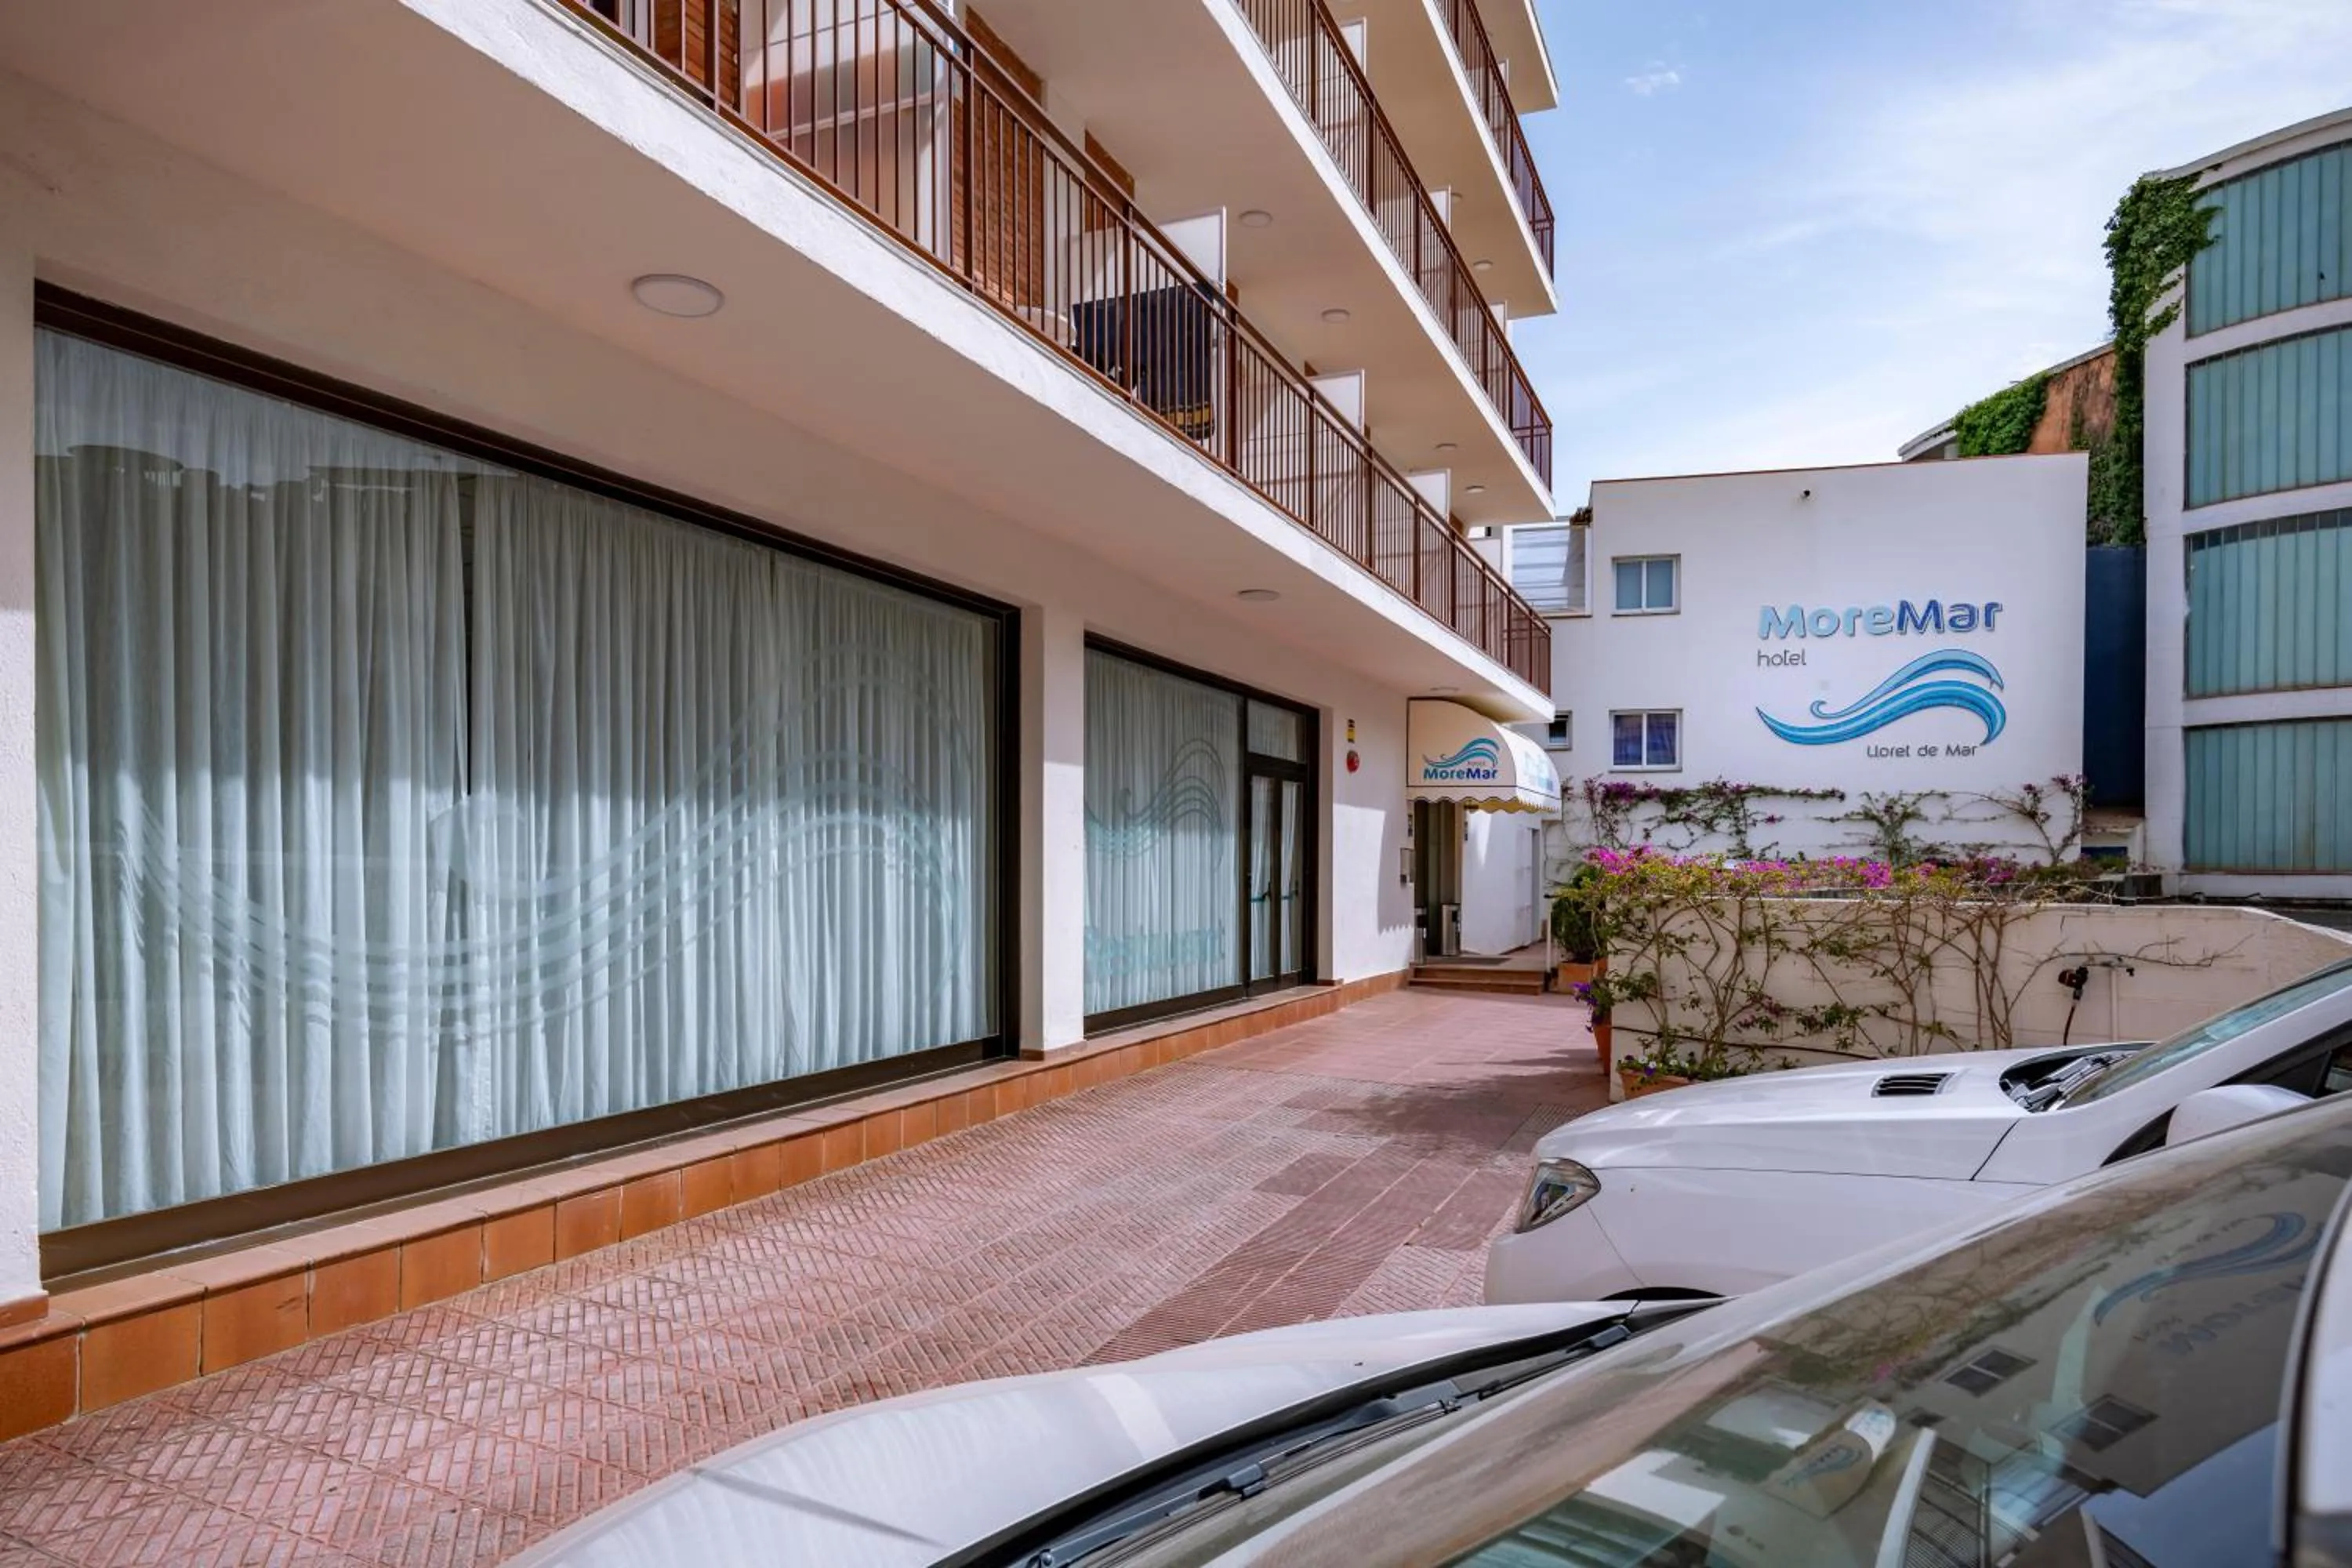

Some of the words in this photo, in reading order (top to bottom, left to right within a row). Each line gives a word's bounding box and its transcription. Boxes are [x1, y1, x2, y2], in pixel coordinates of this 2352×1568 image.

[1758, 600, 2002, 639] MoreMar
[1757, 649, 1806, 666] hotel
[1867, 745, 1910, 757] Lloret
[1917, 745, 1937, 757] de
[1945, 744, 1977, 757] Mar
[1423, 768, 1498, 780] MoreMar
